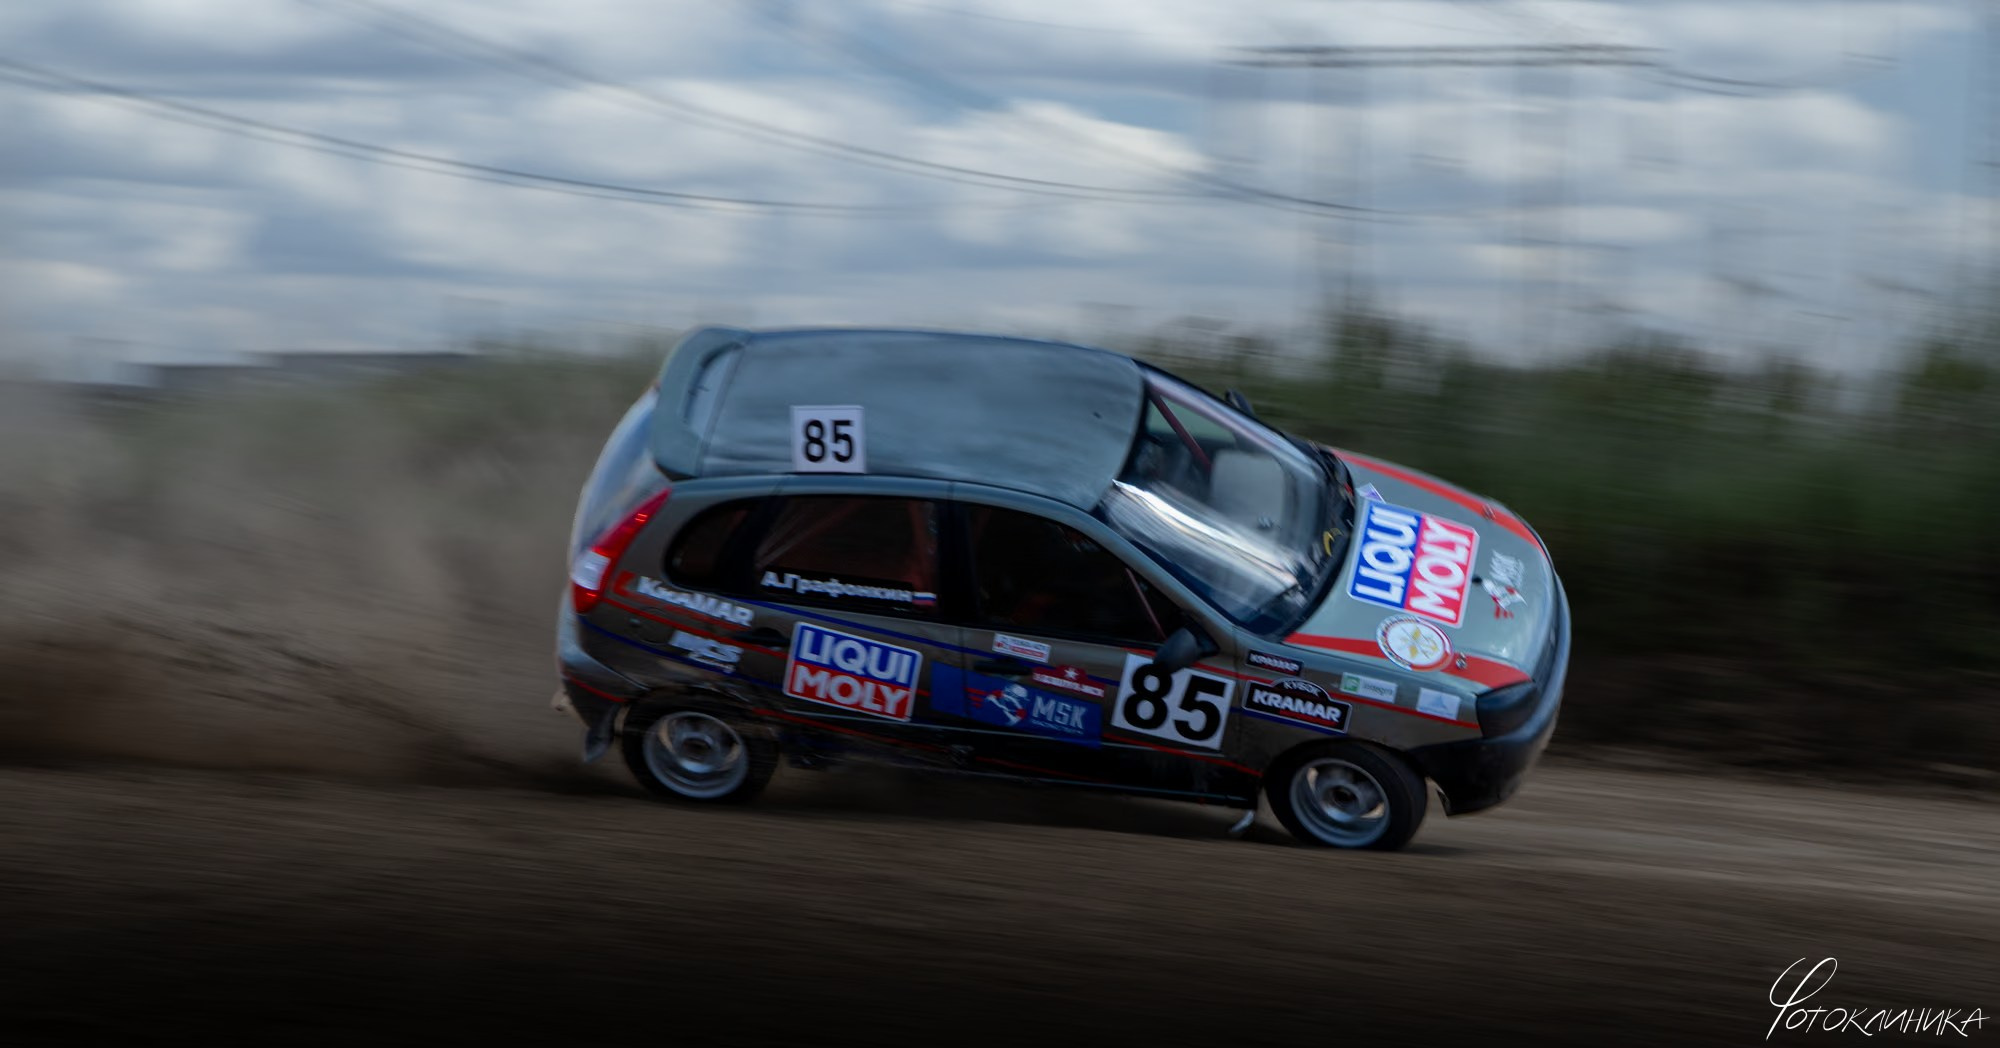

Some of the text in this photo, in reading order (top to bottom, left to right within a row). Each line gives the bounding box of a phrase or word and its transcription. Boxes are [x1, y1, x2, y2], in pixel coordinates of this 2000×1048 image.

[804, 419, 853, 463] 85
[1354, 505, 1419, 604] LIQUI
[1409, 516, 1471, 621] MOLY
[799, 629, 914, 684] LIQUI
[792, 665, 910, 716] MOLY
[1032, 695, 1087, 729] MSK
[1123, 663, 1227, 742] 85
[1252, 689, 1342, 723] KRAMAR
